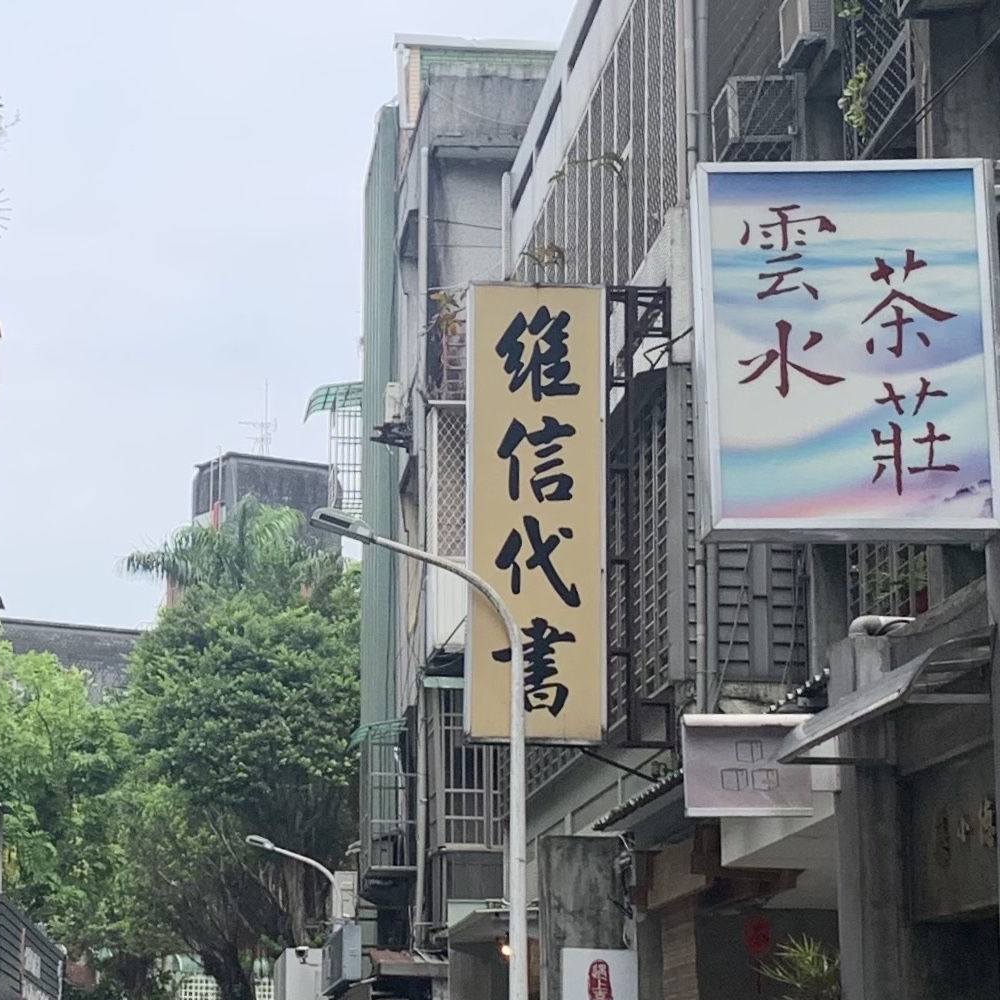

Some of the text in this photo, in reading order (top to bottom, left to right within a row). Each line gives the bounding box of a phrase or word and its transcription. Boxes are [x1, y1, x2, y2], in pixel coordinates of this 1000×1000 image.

[738, 203, 846, 399] 雲水
[860, 248, 961, 497] 茶莊
[491, 304, 582, 718] 維信代書
